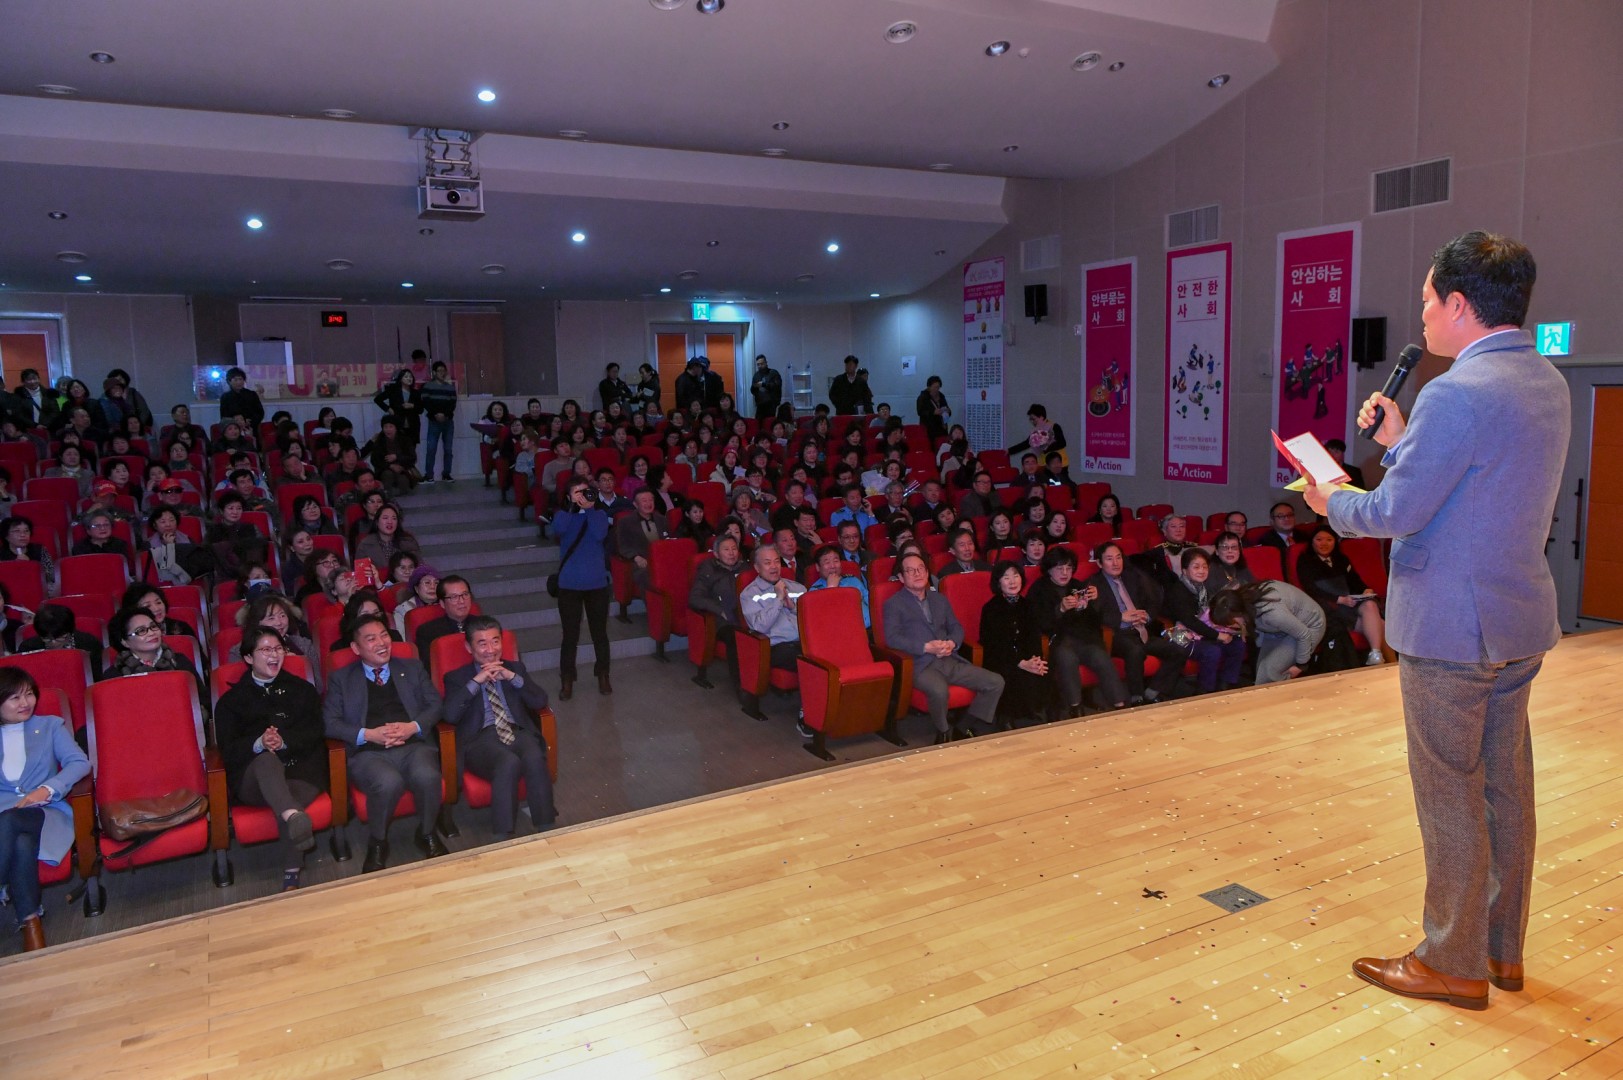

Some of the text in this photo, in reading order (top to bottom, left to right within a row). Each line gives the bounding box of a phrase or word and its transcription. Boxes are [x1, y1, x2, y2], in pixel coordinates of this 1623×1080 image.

[1291, 264, 1343, 286] 안심하는
[1177, 279, 1218, 299] 안전한
[1091, 291, 1126, 307] 안부묻는
[1276, 472, 1290, 483] Re
